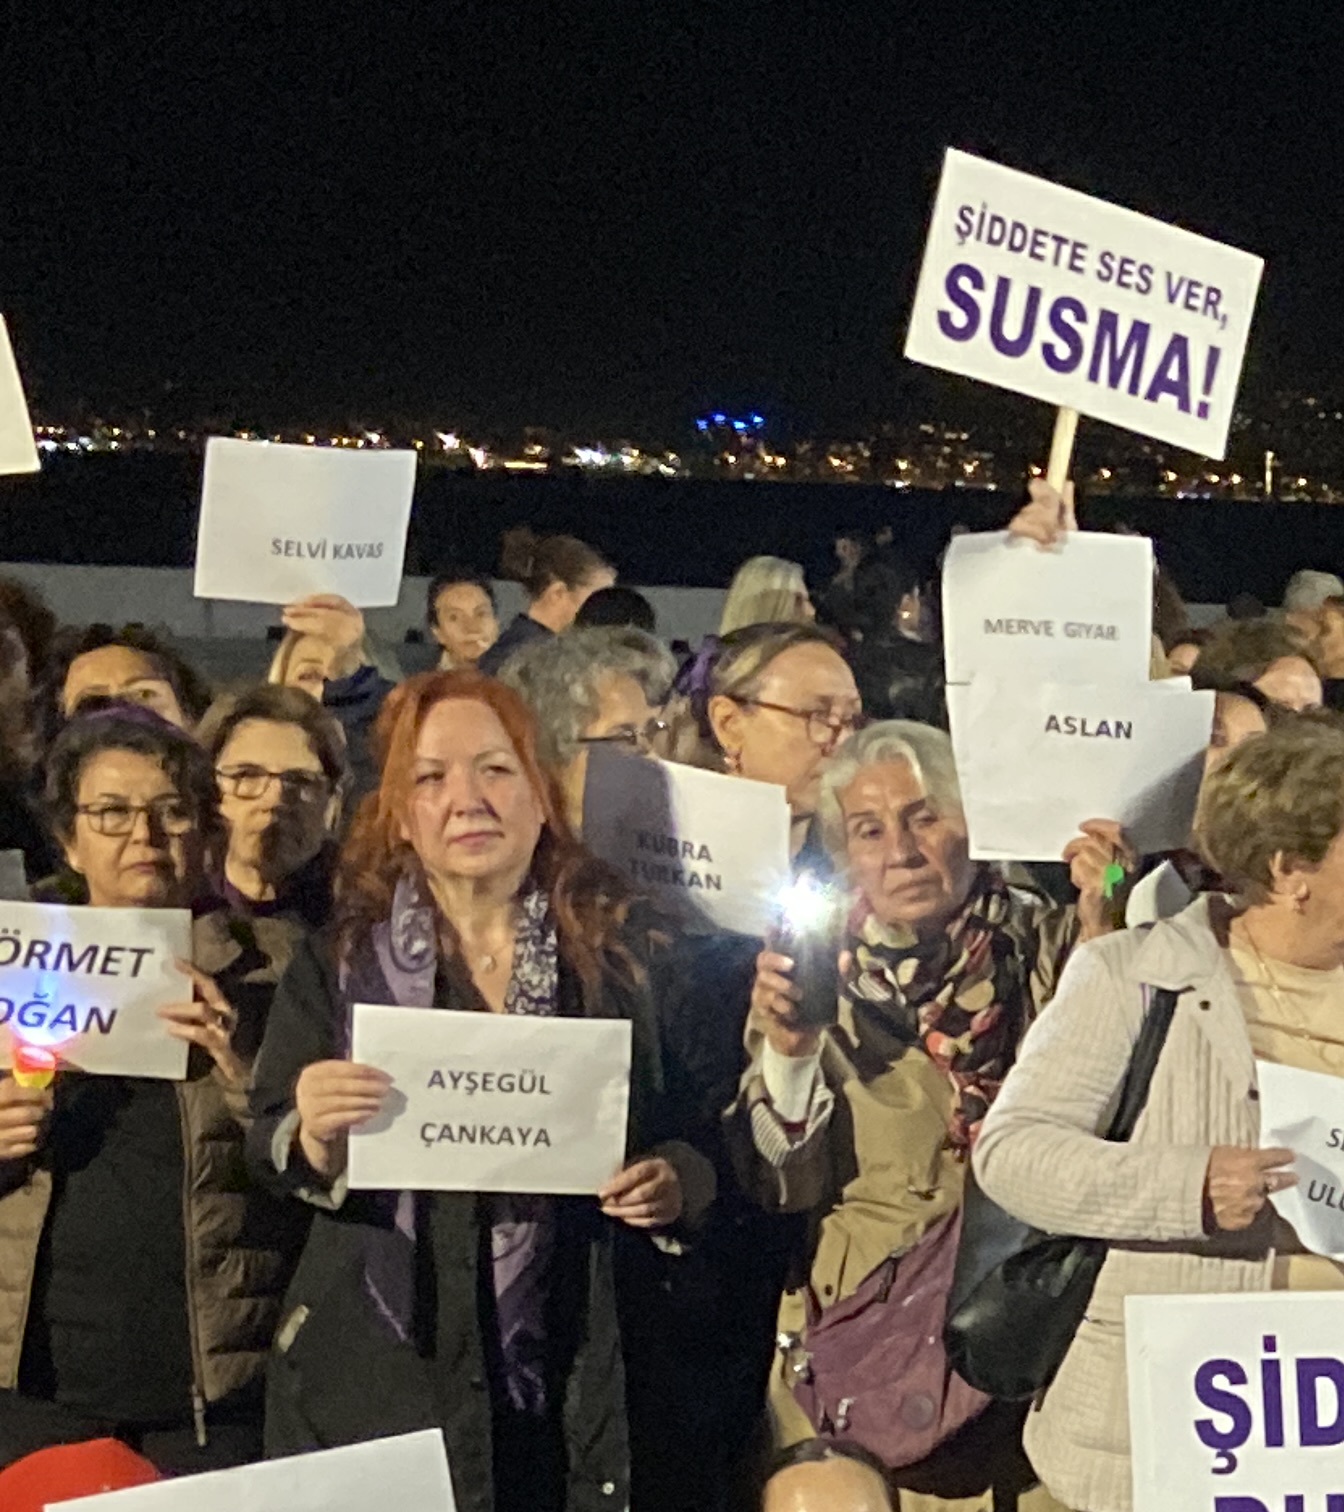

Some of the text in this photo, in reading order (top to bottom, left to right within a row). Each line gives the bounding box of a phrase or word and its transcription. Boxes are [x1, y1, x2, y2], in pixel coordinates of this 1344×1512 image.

[955, 202, 1229, 331] ŞİDDETE SES VER,
[937, 262, 1222, 420] SUSMA!
[984, 618, 1054, 637] MERVE
[1045, 714, 1133, 739] ASLAN
[0, 927, 155, 978] ÖRMET
[0, 992, 118, 1035] OĞAN
[427, 1068, 552, 1096] AYŞEGÜL
[420, 1122, 552, 1148] ÇANKAYA
